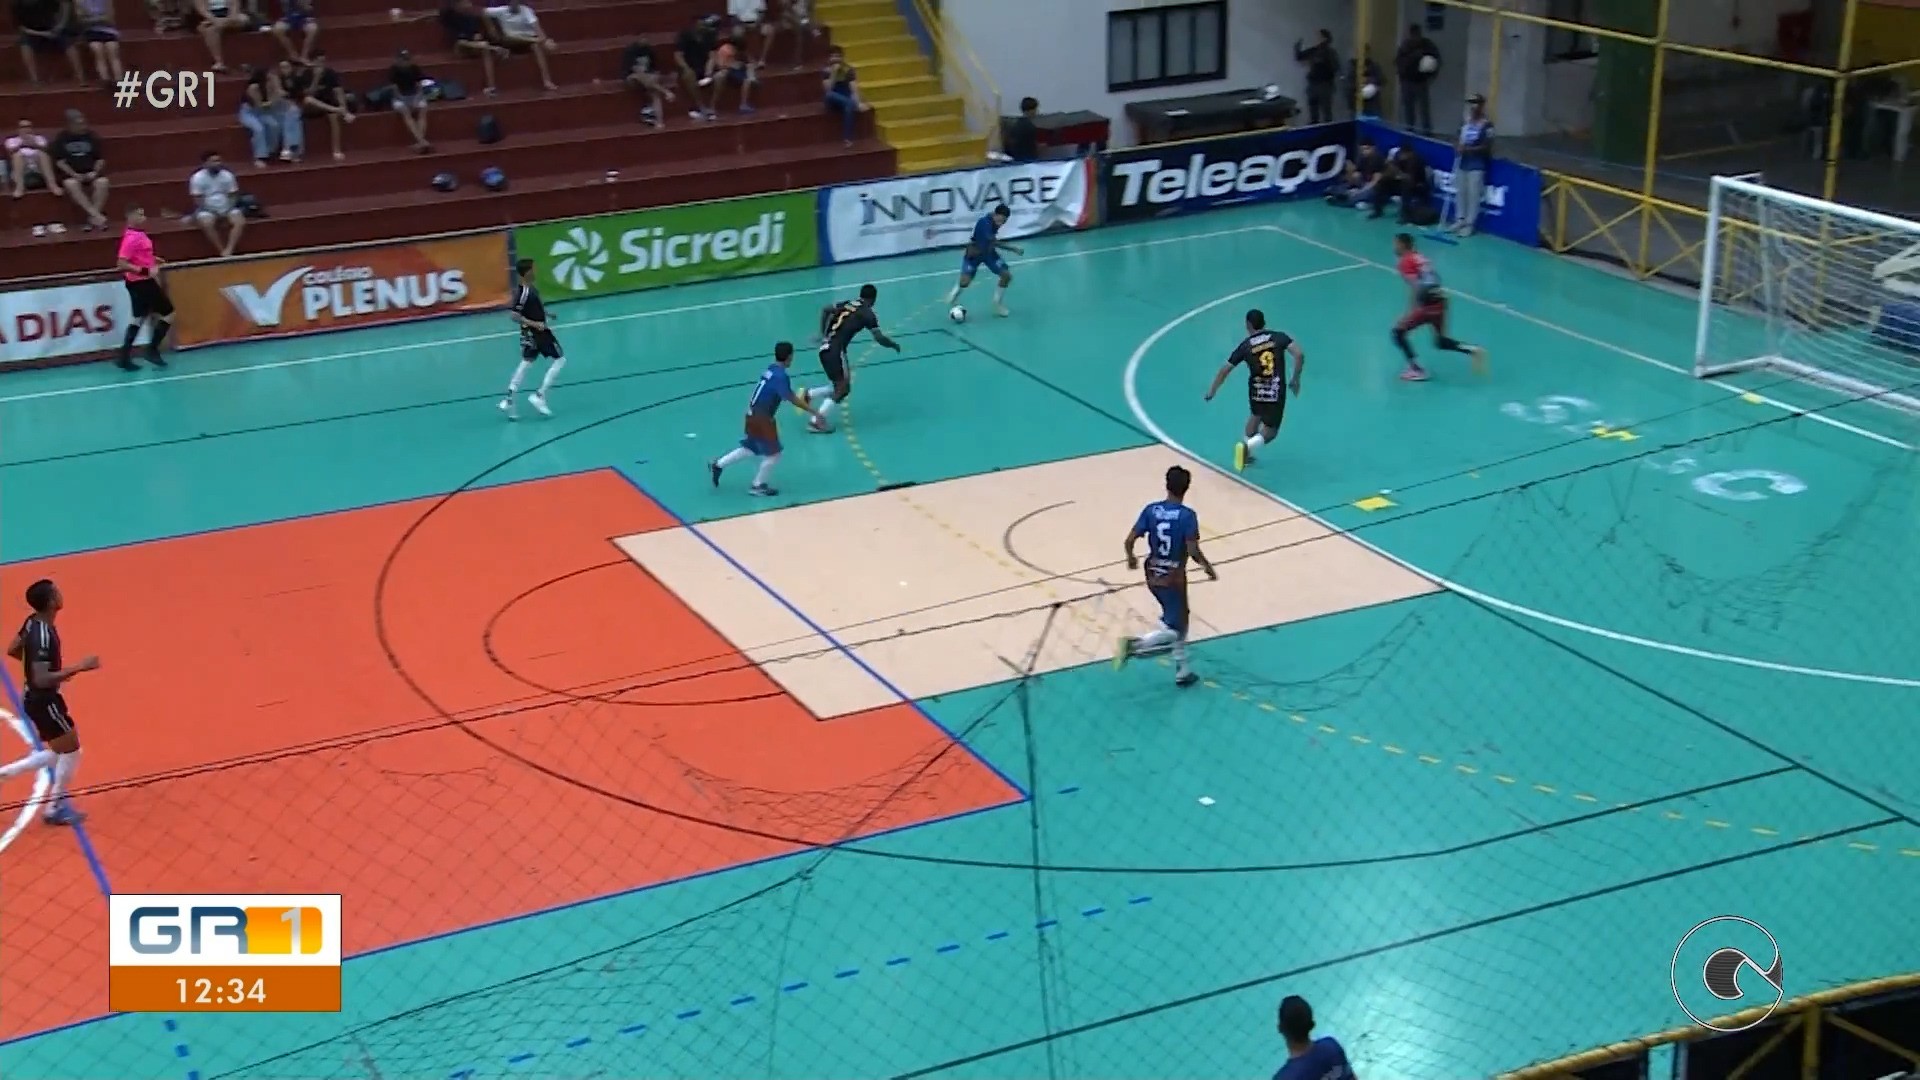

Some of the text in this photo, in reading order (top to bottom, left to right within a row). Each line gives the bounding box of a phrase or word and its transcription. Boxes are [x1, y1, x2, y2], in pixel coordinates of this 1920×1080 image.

[1112, 144, 1347, 206] Teleaço
[618, 211, 786, 274] Sicredi
[302, 269, 468, 321] PLENUS
[15, 304, 114, 343] DIAS
[1259, 351, 1275, 376] 9
[1156, 522, 1172, 556] 5
